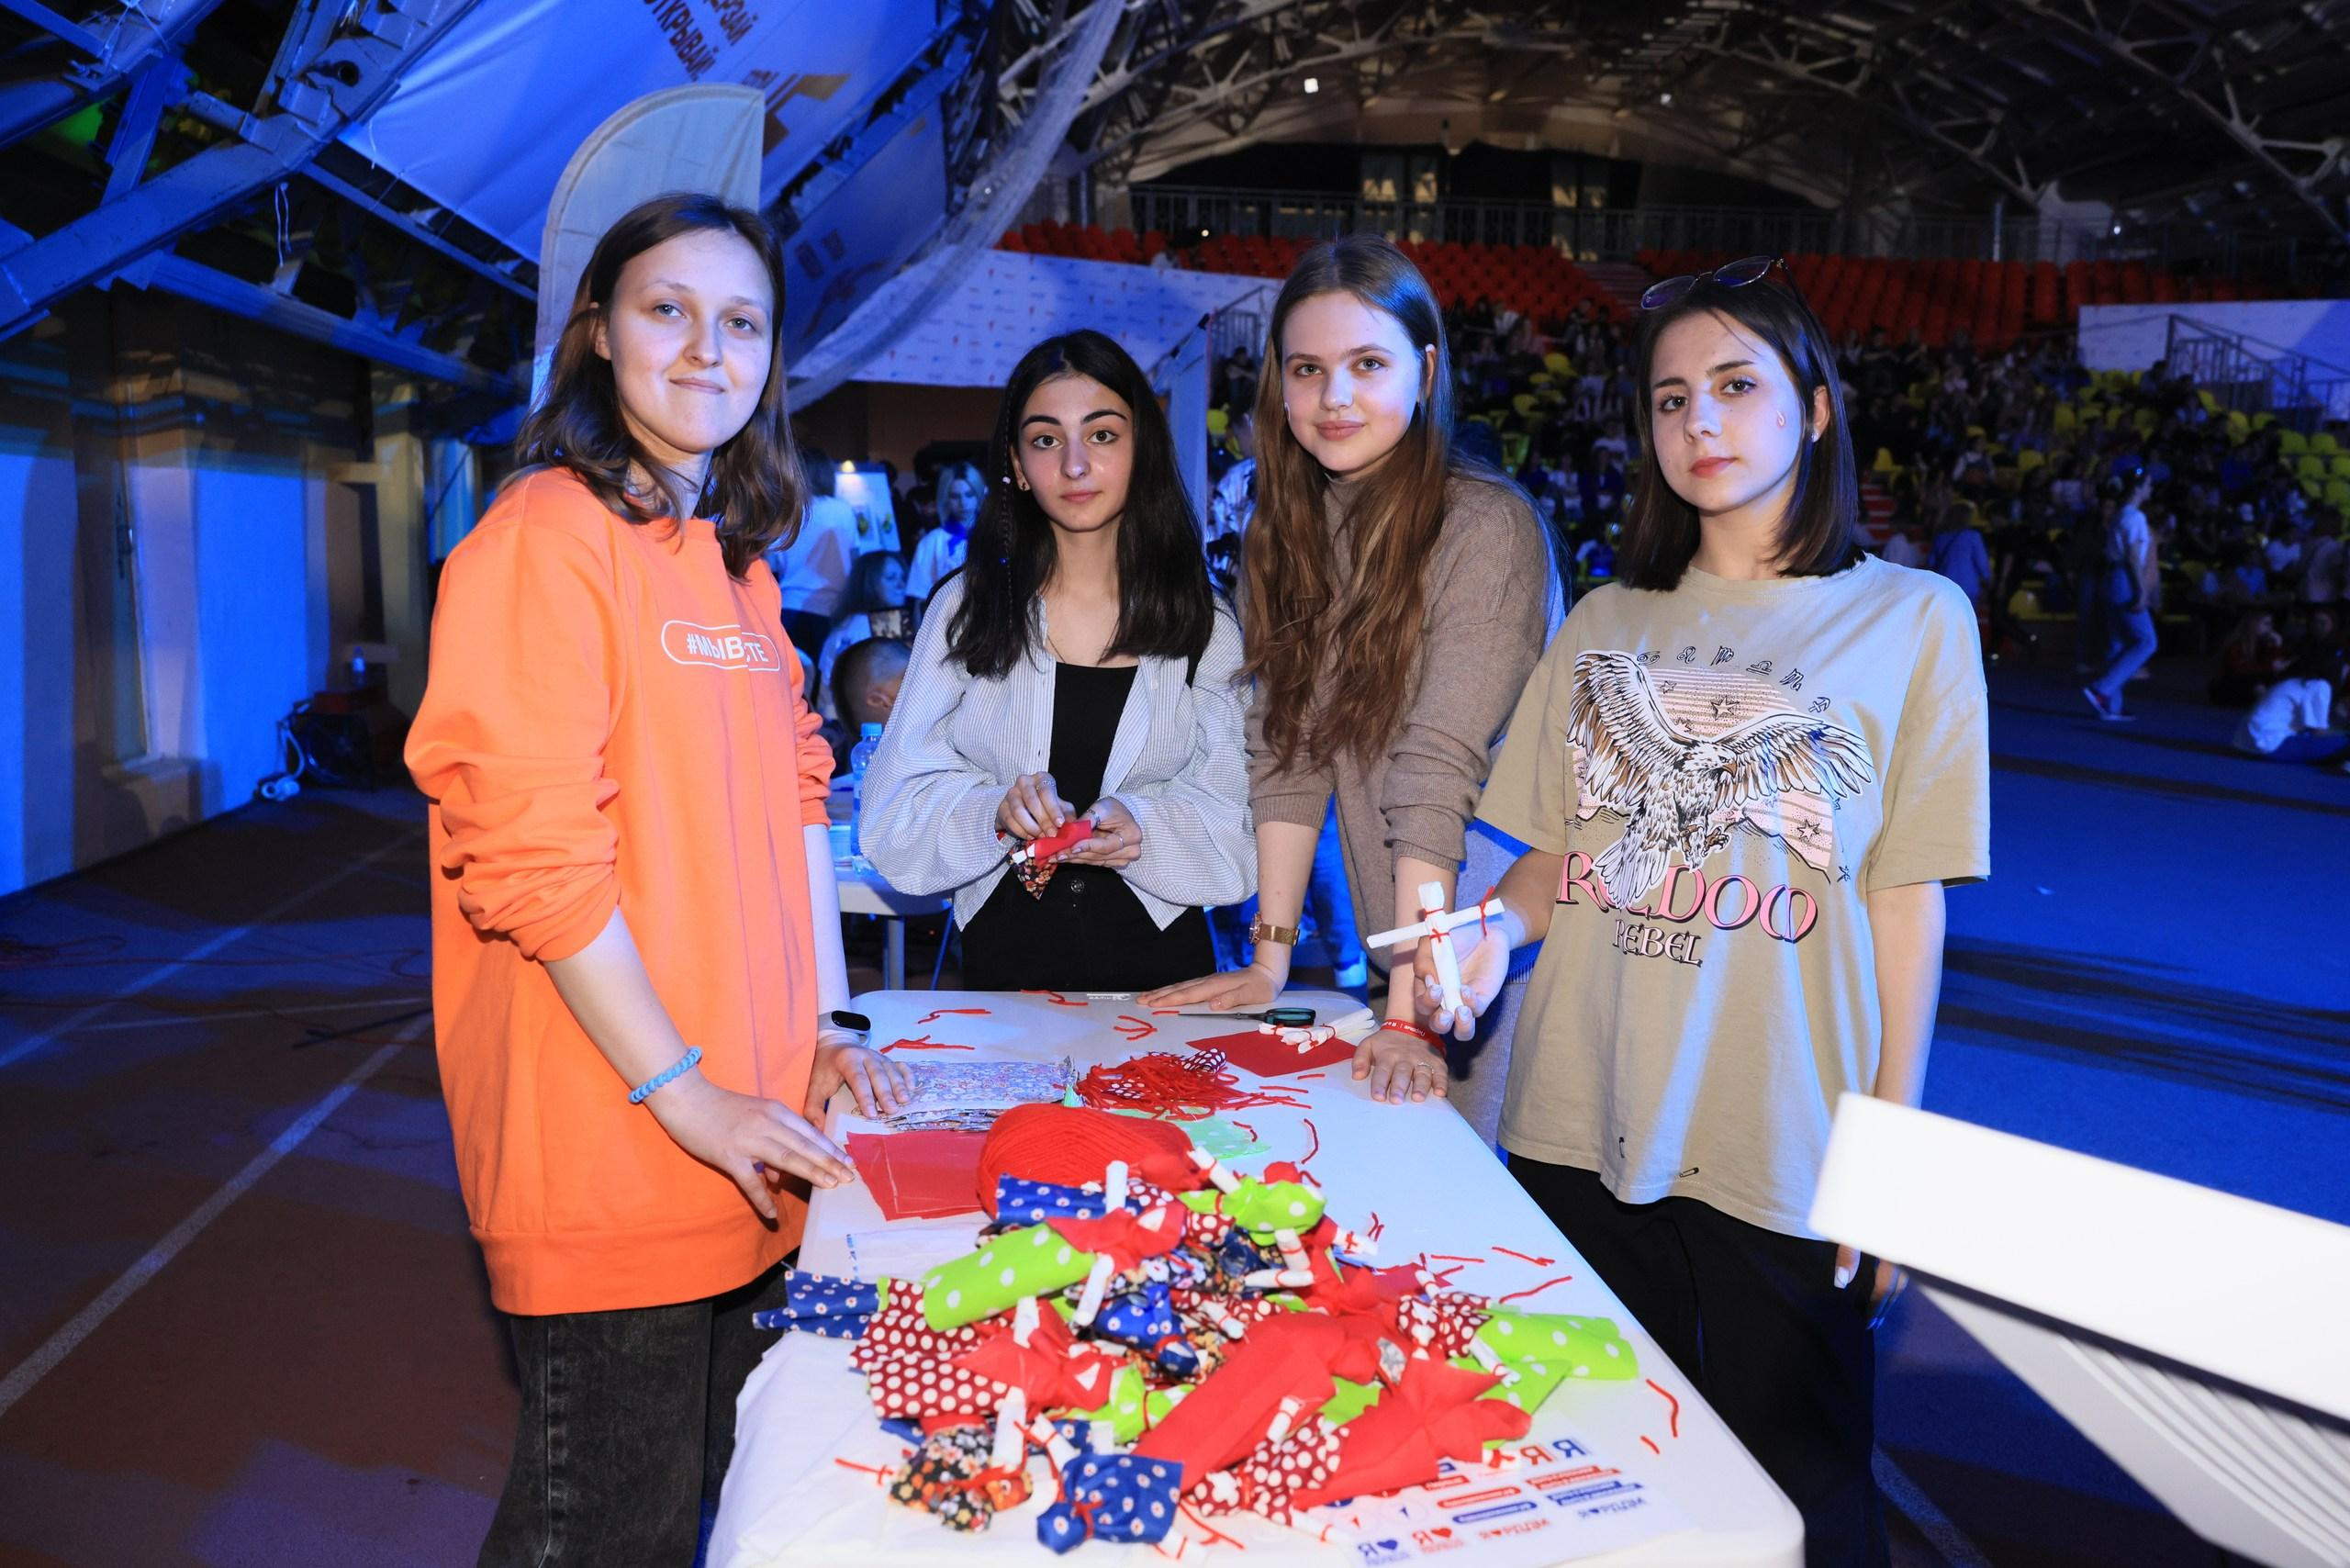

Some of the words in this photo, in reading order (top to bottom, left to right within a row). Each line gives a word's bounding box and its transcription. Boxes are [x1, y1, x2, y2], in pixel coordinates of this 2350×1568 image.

[644, 0, 719, 82] КРЫВАЙ!
[703, 0, 759, 46] РЗАЙ
[1613, 919, 1703, 968] REBEL
